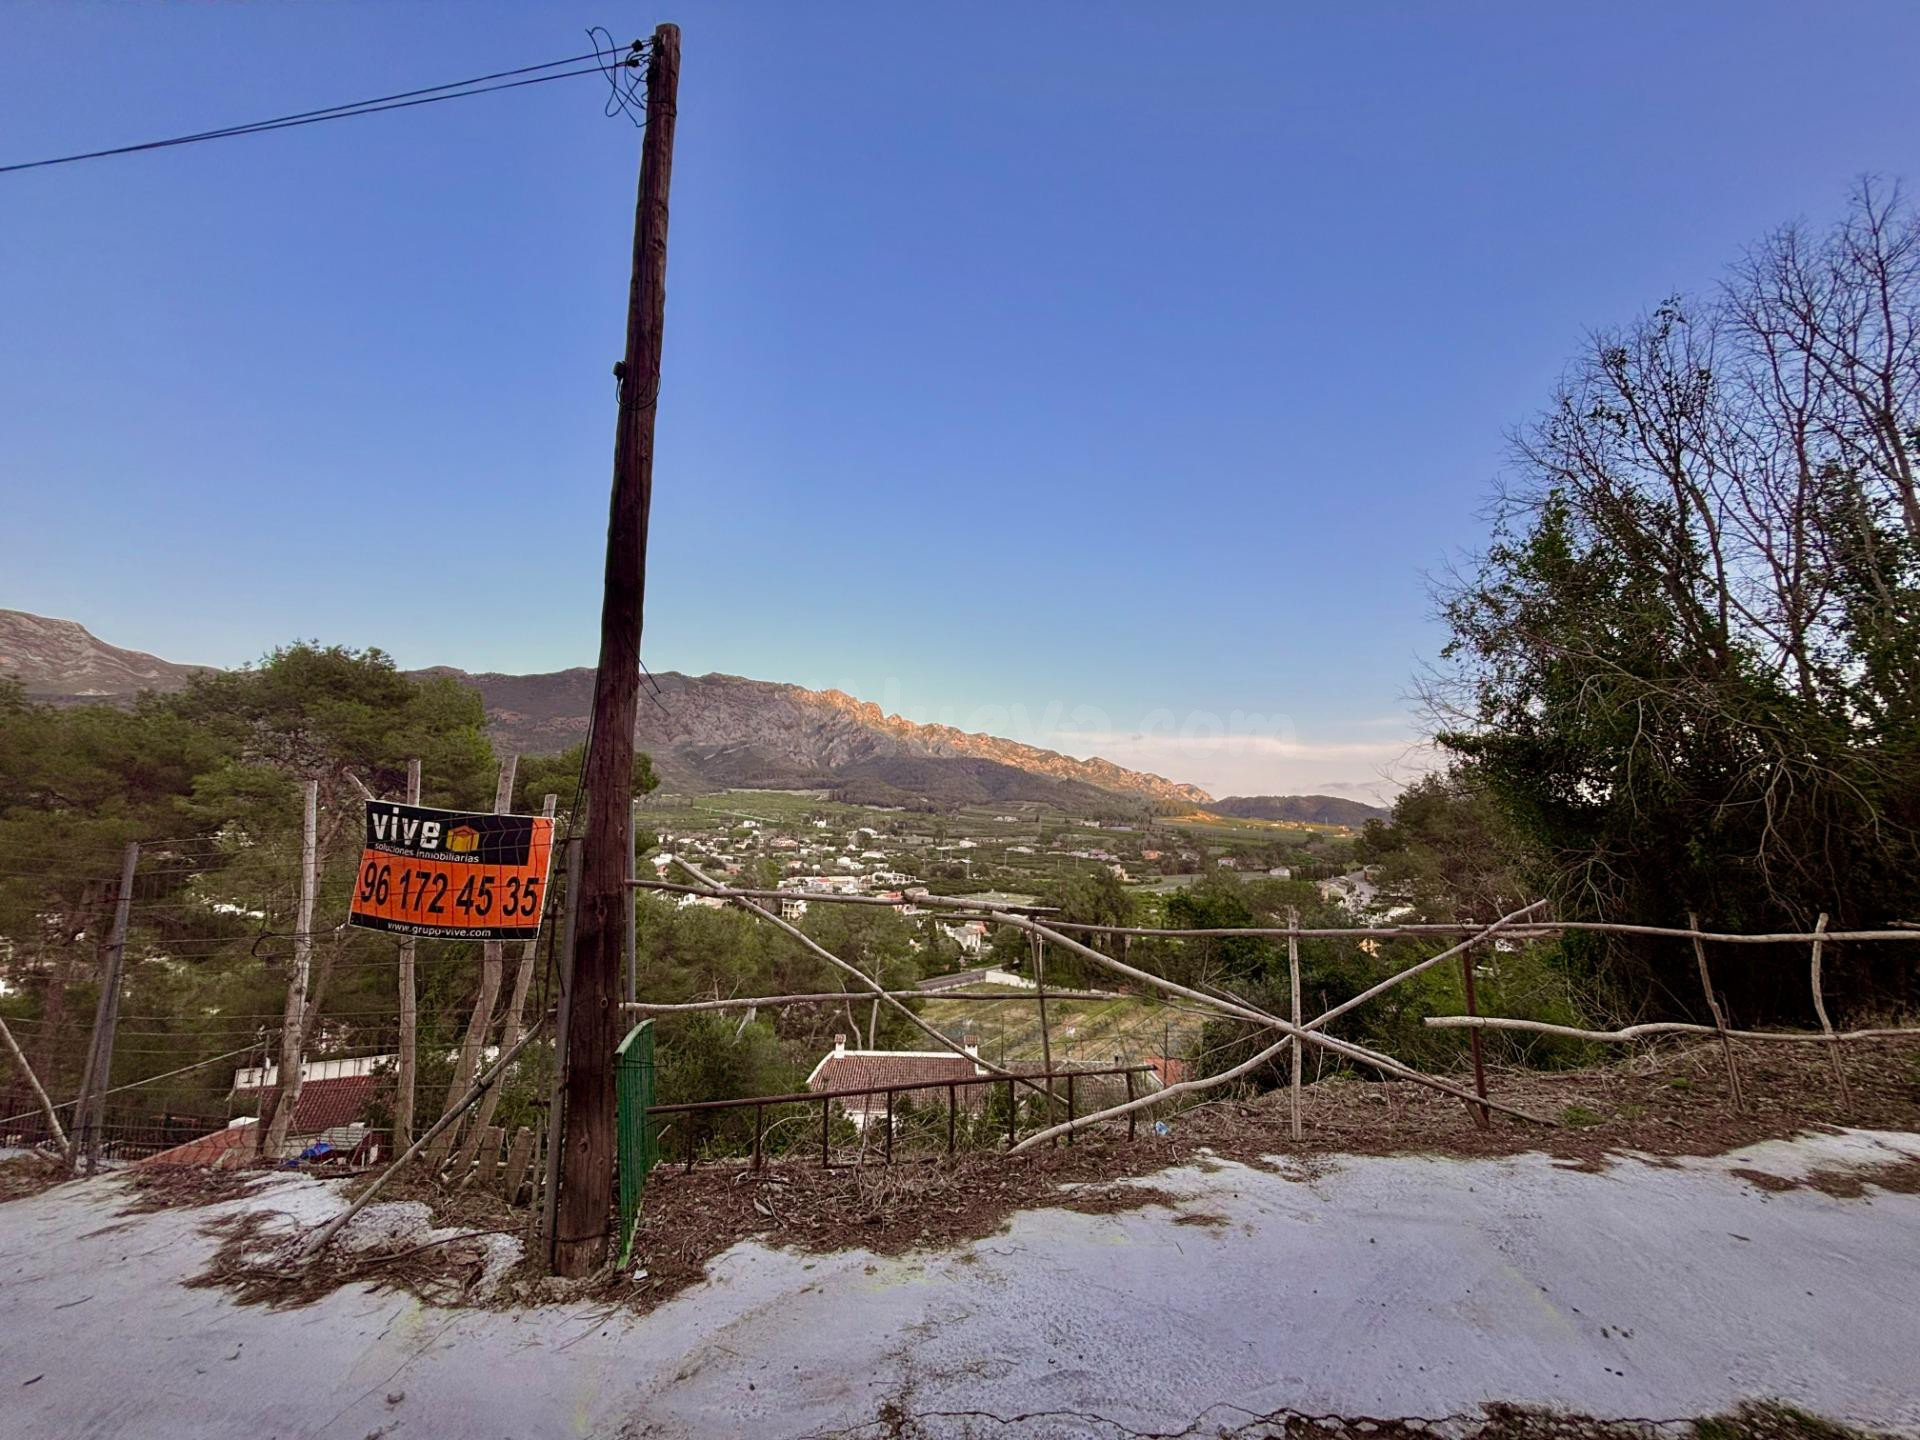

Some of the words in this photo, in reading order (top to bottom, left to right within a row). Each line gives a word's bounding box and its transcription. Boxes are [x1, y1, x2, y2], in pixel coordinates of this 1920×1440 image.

[372, 807, 441, 849] vive
[374, 842, 414, 857] soluciones
[416, 848, 480, 863] inmobiliarias
[360, 861, 391, 906] 96
[399, 868, 448, 914] 172
[455, 875, 495, 916] 45
[502, 876, 540, 917] 35
[387, 921, 491, 937] www.grupo-vive.com
